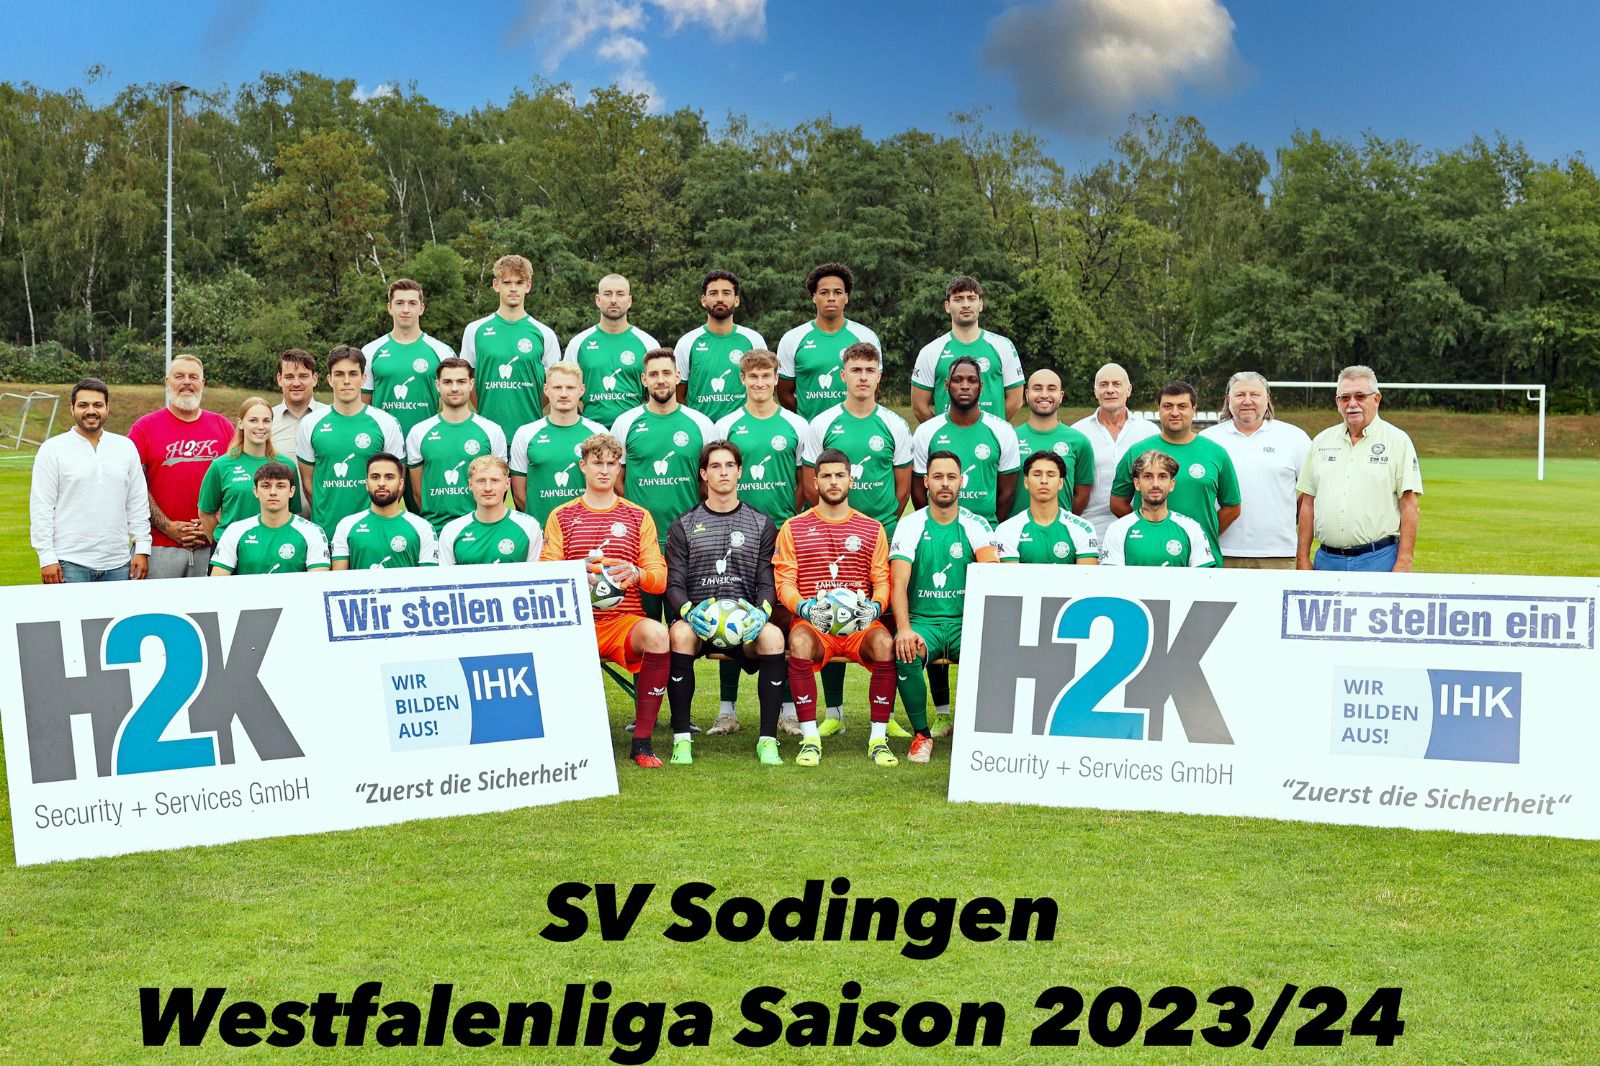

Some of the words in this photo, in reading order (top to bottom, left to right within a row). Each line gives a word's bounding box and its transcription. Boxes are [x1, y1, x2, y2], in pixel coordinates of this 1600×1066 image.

[165, 439, 218, 459] H2K
[430, 487, 469, 496] ZAHNBLICK
[638, 477, 678, 487] ZAHNBLICK
[736, 482, 775, 491] ZAHNBLICK
[540, 488, 579, 498] ZAHNBLICK
[918, 589, 956, 598] ZAHNBLICK
[338, 597, 392, 633] Wir
[402, 592, 504, 629] stellen
[512, 588, 567, 622] ein!
[1298, 599, 1358, 633] Wir
[1368, 601, 1492, 638] stellen
[1506, 605, 1577, 640] ein!
[974, 595, 1237, 745] H2K
[391, 674, 428, 692] WIR
[470, 666, 534, 703] IHK
[1343, 679, 1384, 696] WIR
[16, 608, 306, 784] H2K
[395, 694, 460, 716] BILDEN
[1440, 684, 1514, 719] IHK
[1343, 703, 1419, 722] BILDEN
[399, 720, 439, 740] AUS!
[1341, 727, 1389, 745] AUS!
[971, 750, 1050, 780] Security
[1057, 761, 1072, 776] +
[1079, 756, 1163, 782] Services
[1171, 760, 1233, 785] GmbH
[440, 774, 472, 796] die
[34, 800, 123, 830] Security
[132, 801, 148, 818] +
[155, 790, 243, 816] Services
[250, 776, 310, 806] GmbH
[1380, 785, 1418, 807] die
